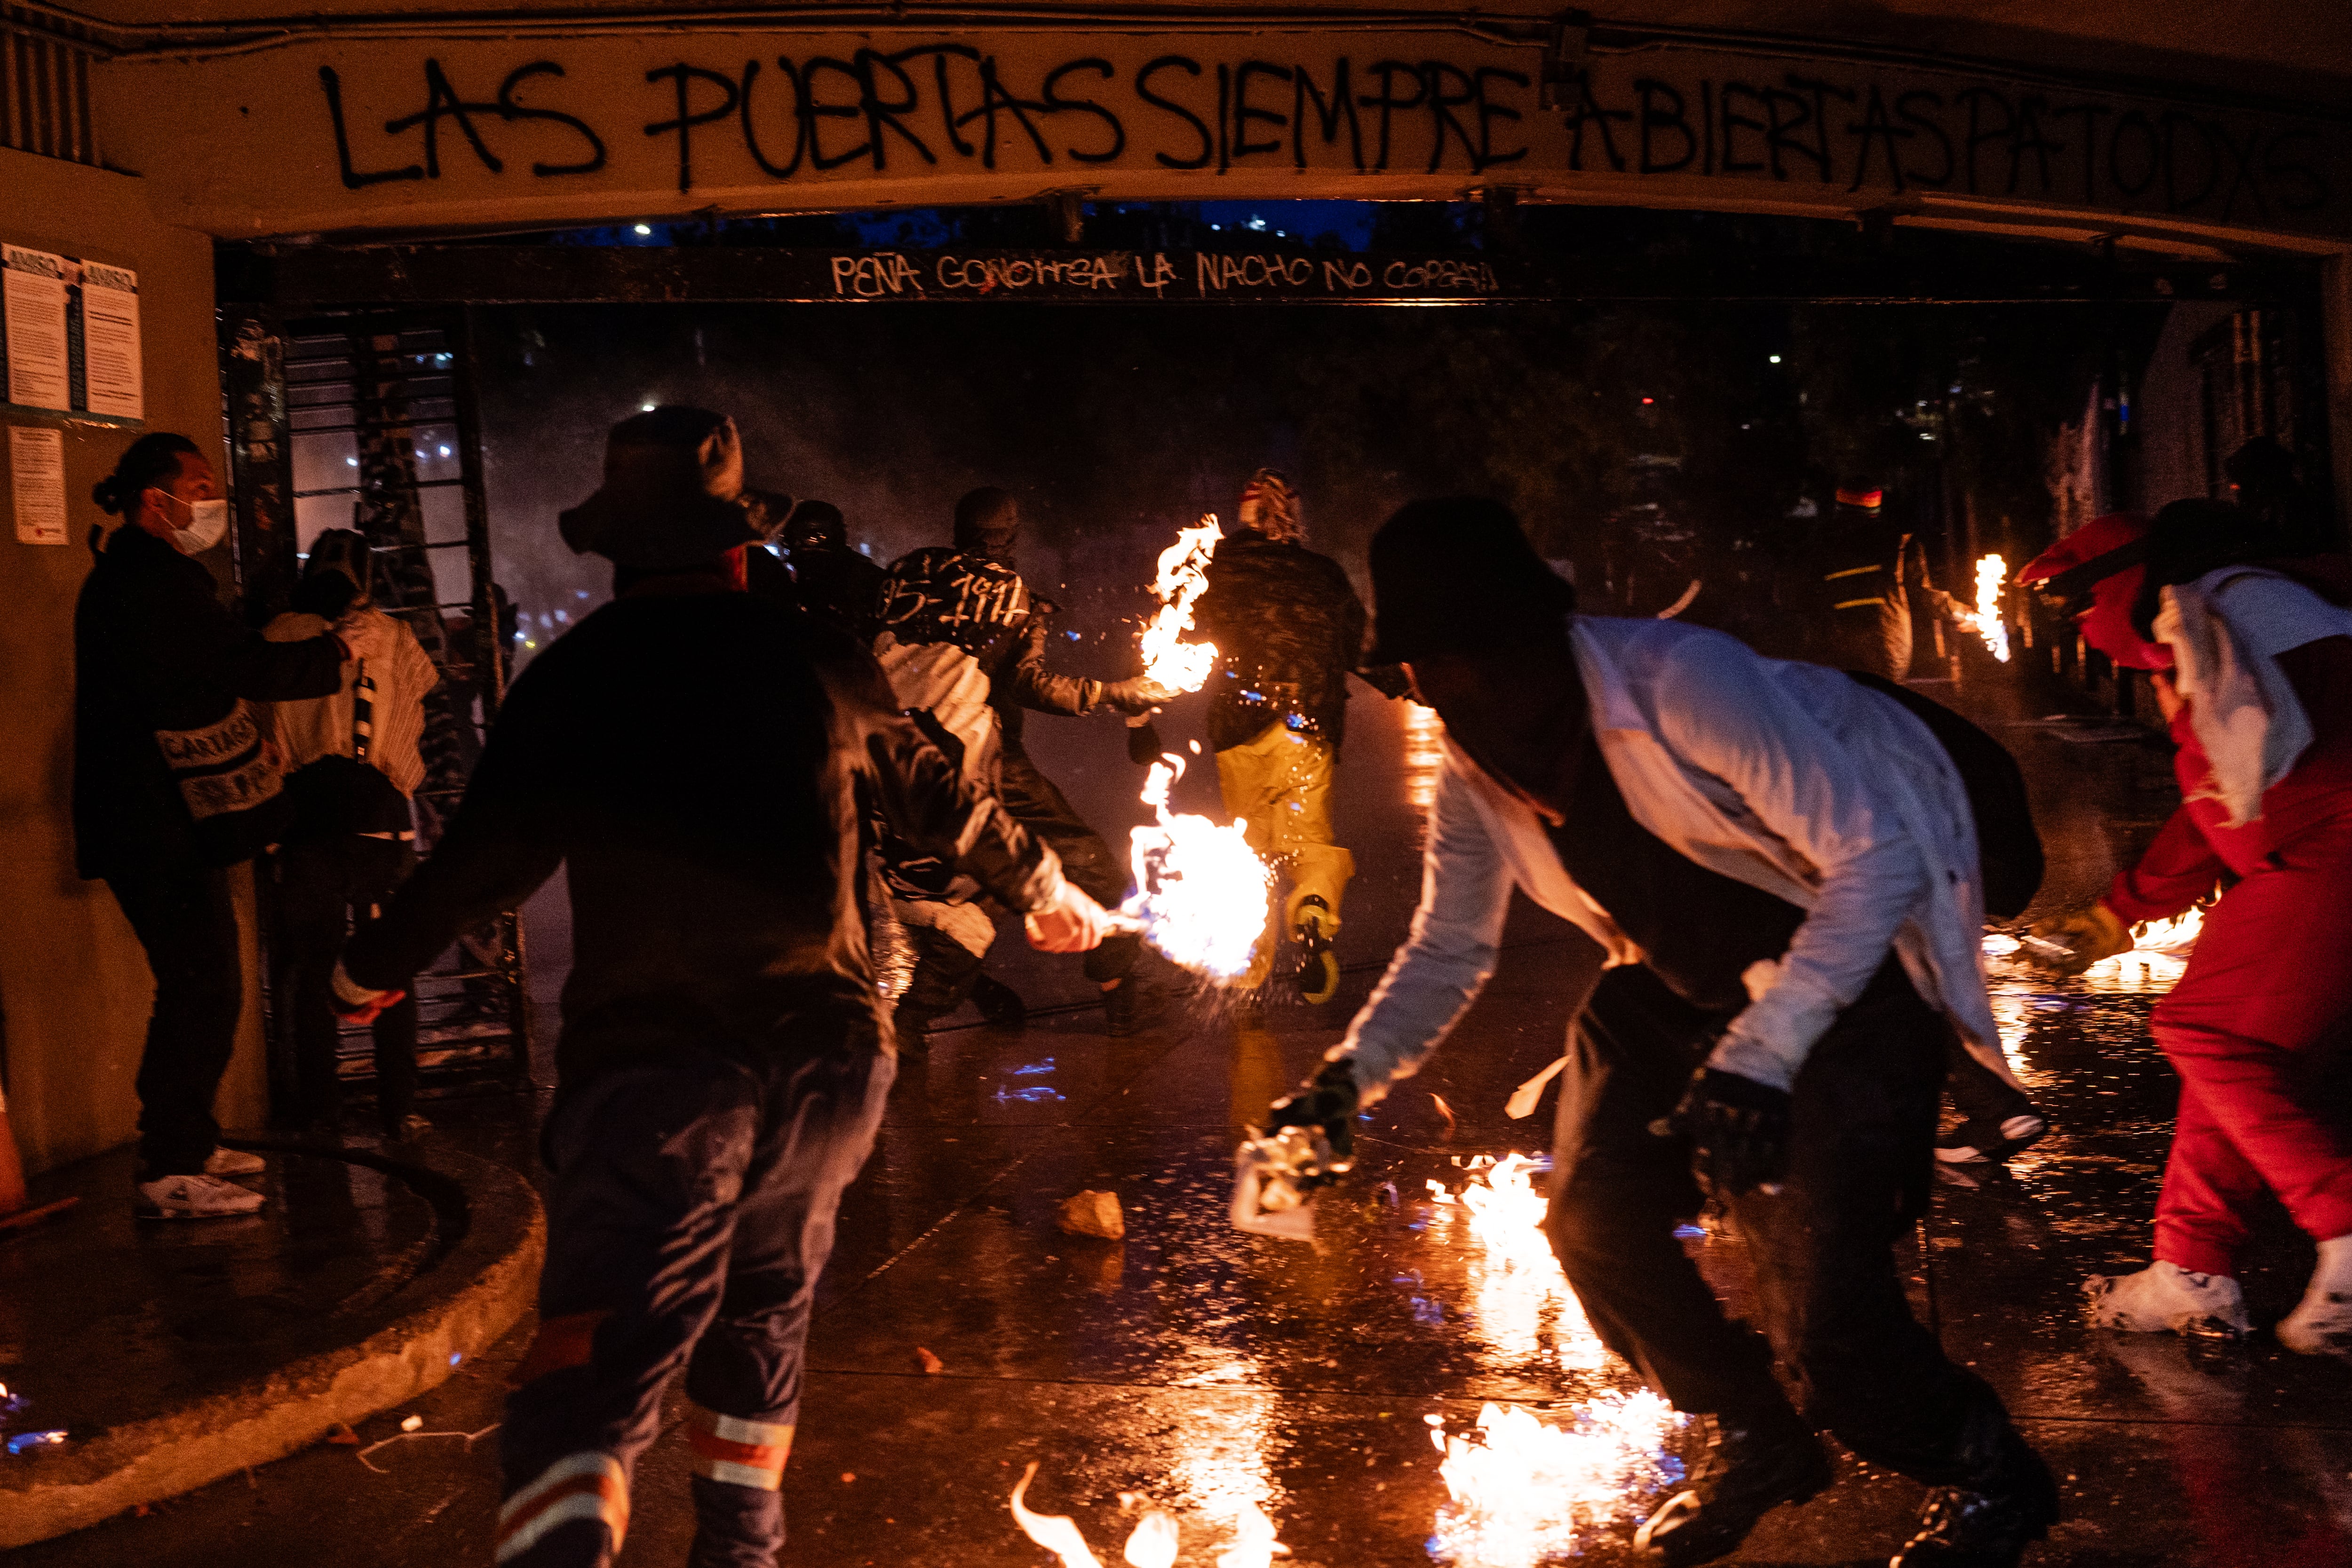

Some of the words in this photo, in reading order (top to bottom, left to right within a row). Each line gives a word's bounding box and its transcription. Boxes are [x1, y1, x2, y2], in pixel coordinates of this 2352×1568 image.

[319, 58, 605, 189] LAS
[645, 43, 1124, 193] PUERTAS
[1136, 56, 1529, 174] SIEMPRE
[1565, 70, 1954, 193] ABIERTAS
[2053, 102, 2330, 222] TODXS
[830, 251, 923, 297] PEÑA
[1135, 252, 1177, 300] LA
[1196, 251, 1314, 298] NACHO
[1322, 258, 1373, 292] NO
